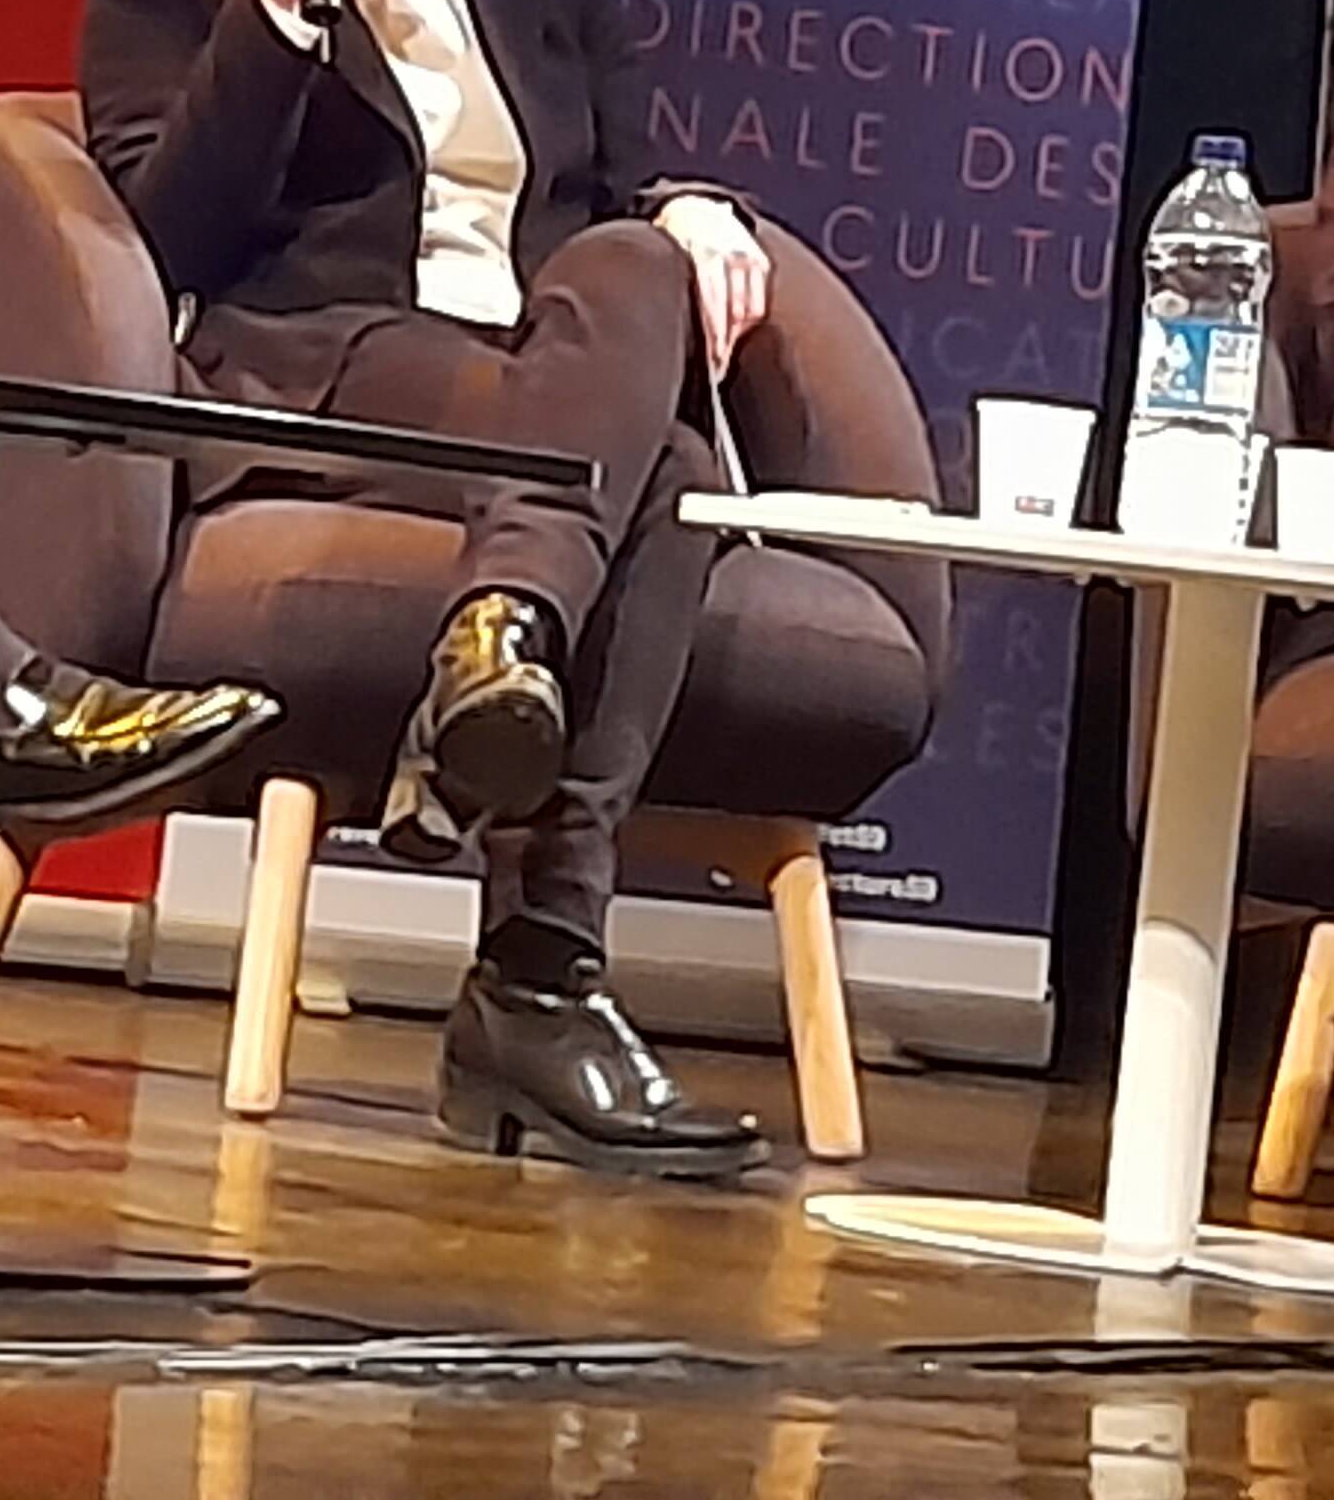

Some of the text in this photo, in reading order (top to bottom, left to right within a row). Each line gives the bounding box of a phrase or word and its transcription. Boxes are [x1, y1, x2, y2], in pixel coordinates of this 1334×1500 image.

[648, 85, 1124, 206] NALE DES
[821, 204, 1113, 301] CULTU
